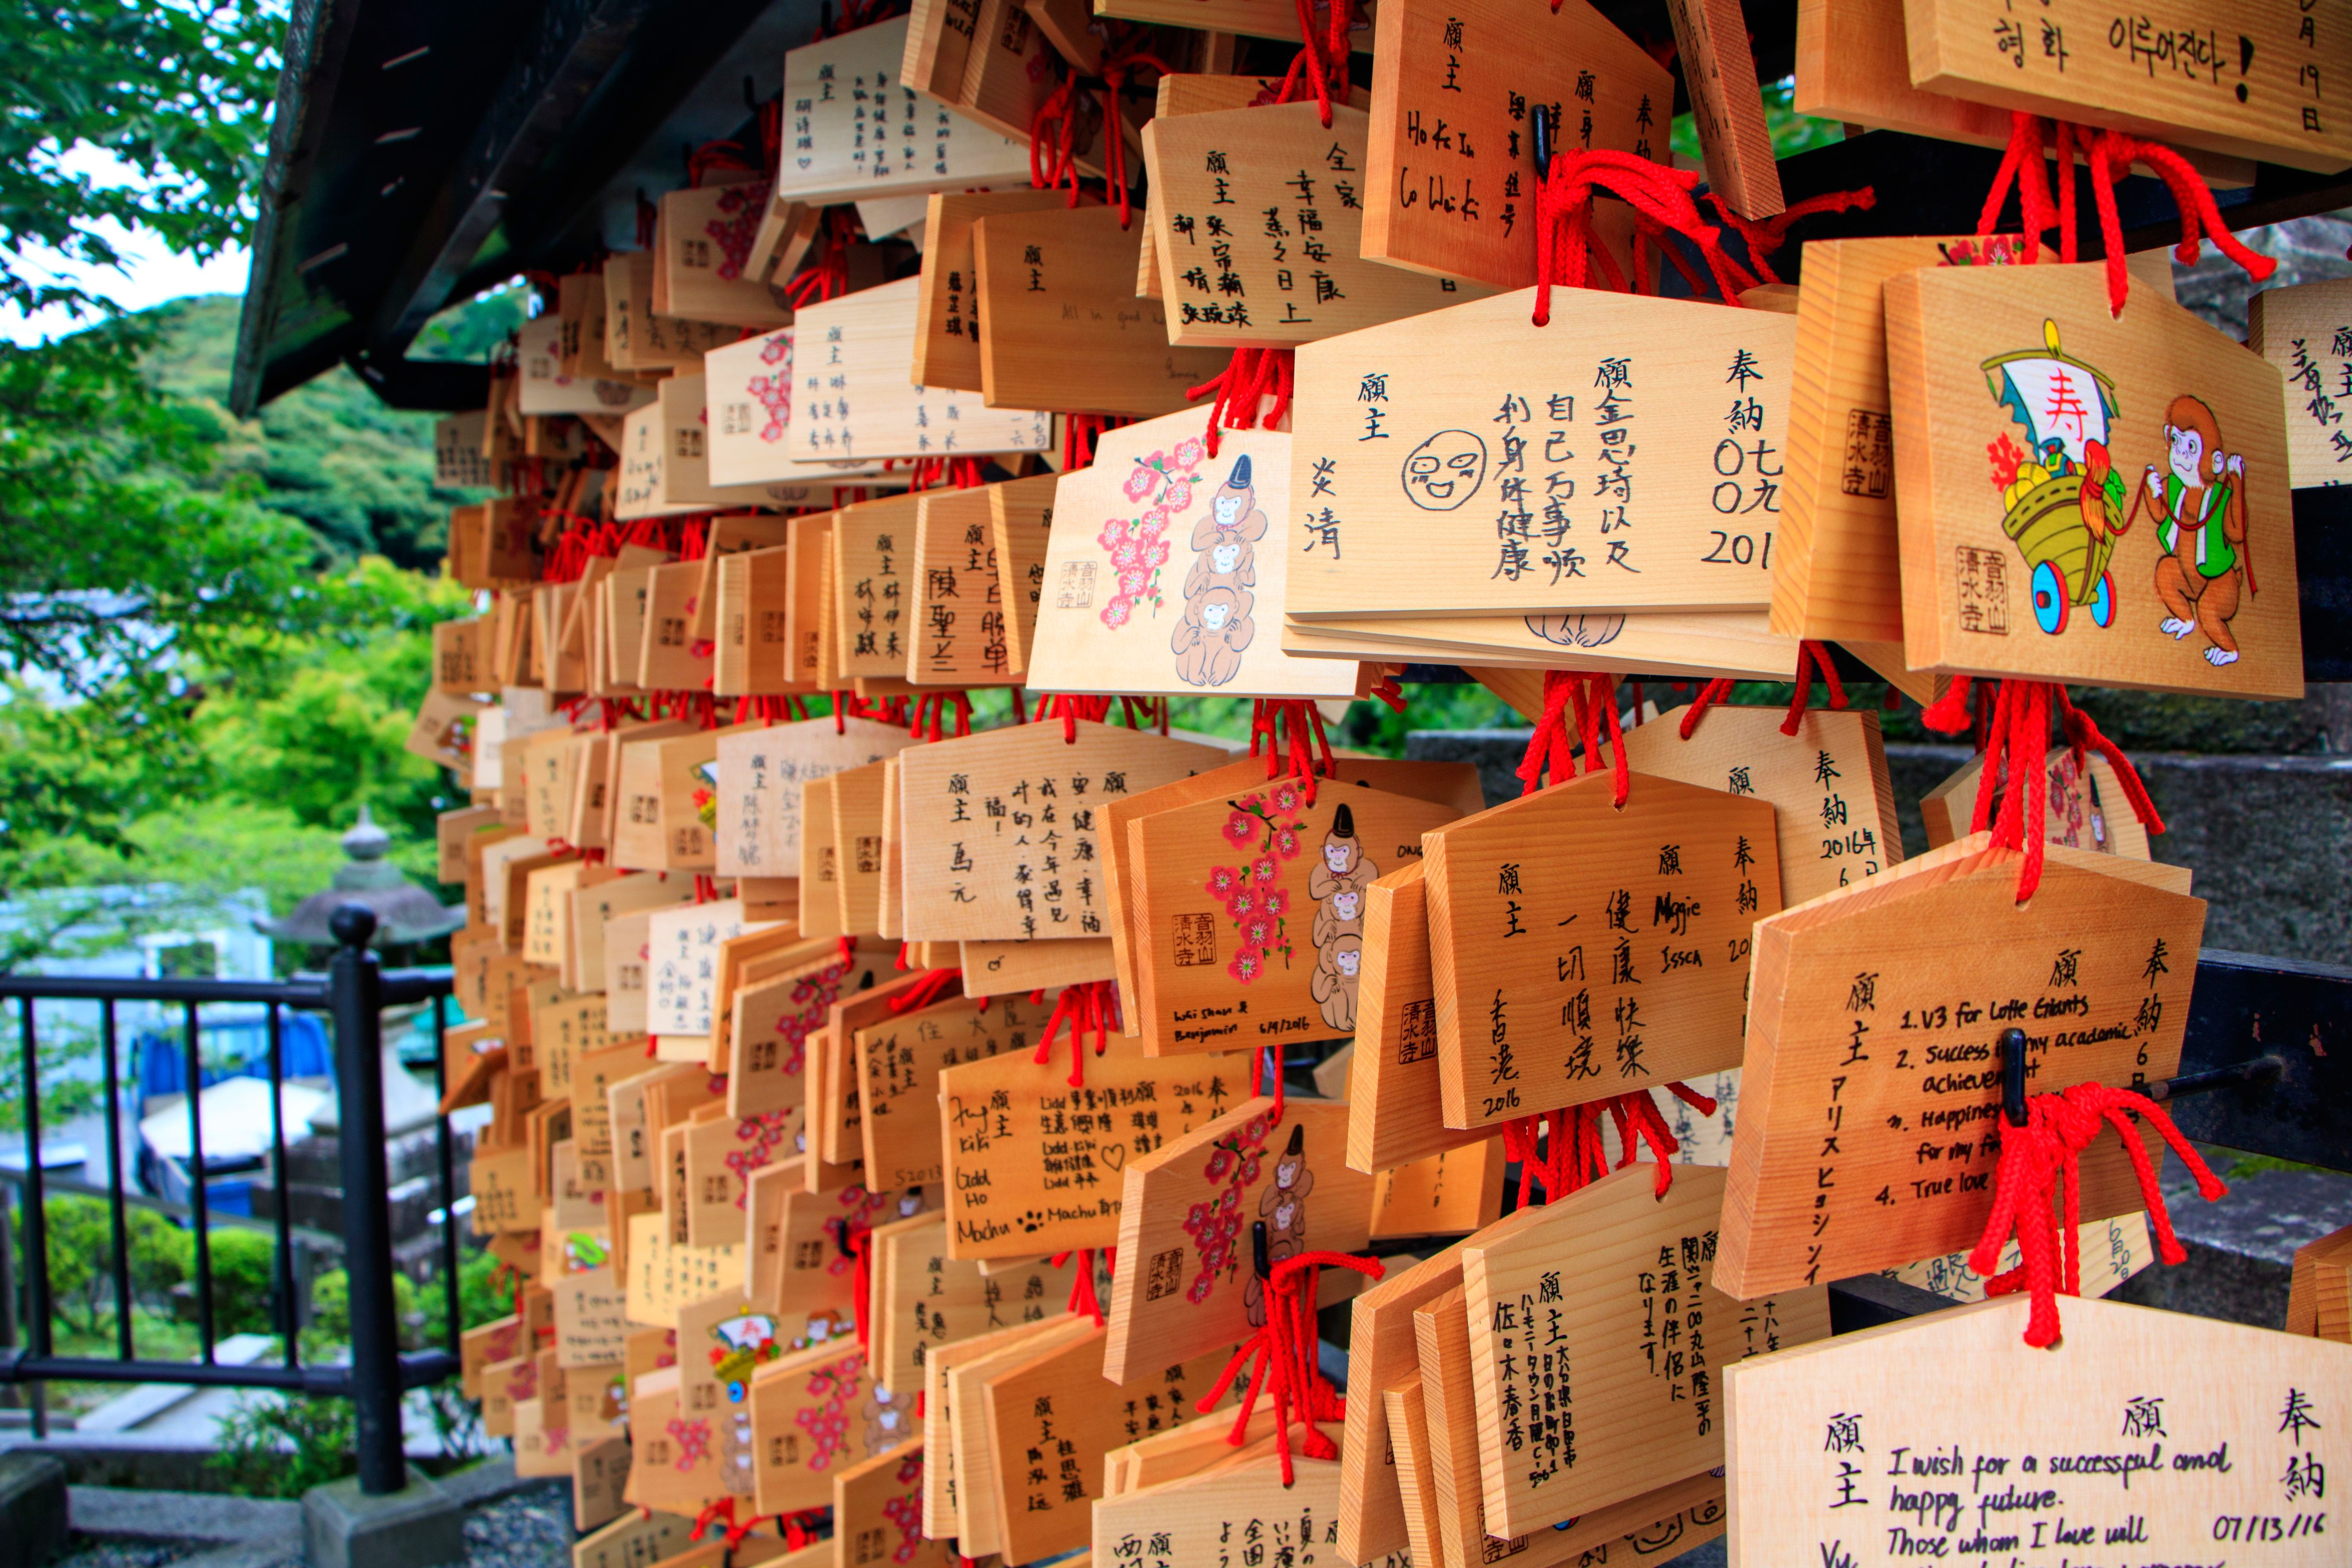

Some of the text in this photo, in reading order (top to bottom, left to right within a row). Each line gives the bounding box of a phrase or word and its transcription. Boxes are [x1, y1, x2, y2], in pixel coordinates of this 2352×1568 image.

[1442, 17, 1464, 92] 願主
[1575, 70, 1595, 105] 願
[1206, 151, 1235, 204] 願主
[1327, 142, 1364, 211] 全家
[1286, 170, 1345, 304] 幸福安康
[1024, 245, 1045, 292] 願主
[1593, 357, 1632, 389] 願
[1724, 349, 1764, 434] 奉納
[1357, 373, 1390, 442] 願主
[876, 533, 895, 576] 願主
[964, 524, 985, 572] 願主
[1959, 551, 1984, 632] 清水寺
[1983, 552, 2007, 631] 音羽山
[948, 773, 971, 822] 願主
[1815, 750, 1847, 829] 奉納
[1658, 844, 1682, 875] 願
[1734, 835, 1758, 915] 奉納
[1498, 863, 1526, 938] 願主
[1175, 915, 1195, 965] 清水寺
[1194, 913, 1214, 962] 音羽山
[2049, 949, 2082, 988] 願
[2133, 938, 2169, 1034] 奉納
[1400, 1004, 1421, 1063] 清水寺
[1840, 973, 1879, 1067] 願主
[1955, 1002, 1982, 1028] for
[1925, 1043, 1990, 1064] Success
[990, 1090, 1013, 1139] 願主
[1483, 1088, 1521, 1117] 2016
[1922, 1102, 2000, 1131] Happines
[1916, 1142, 1944, 1164] for
[1910, 1177, 1953, 1200] True
[1539, 1272, 1567, 1346] 願主
[1034, 1396, 1056, 1444] 願主
[2122, 1396, 2167, 1438] 願
[1824, 1412, 1869, 1509] 願主
[1887, 1441, 2232, 1494] I wish for a successful and
[2278, 1387, 2326, 1502] 奉納
[1889, 1484, 2064, 1533] happy future.
[2212, 1512, 2327, 1542] 07/13/16
[1887, 1514, 2149, 1558] Those whom I love will
